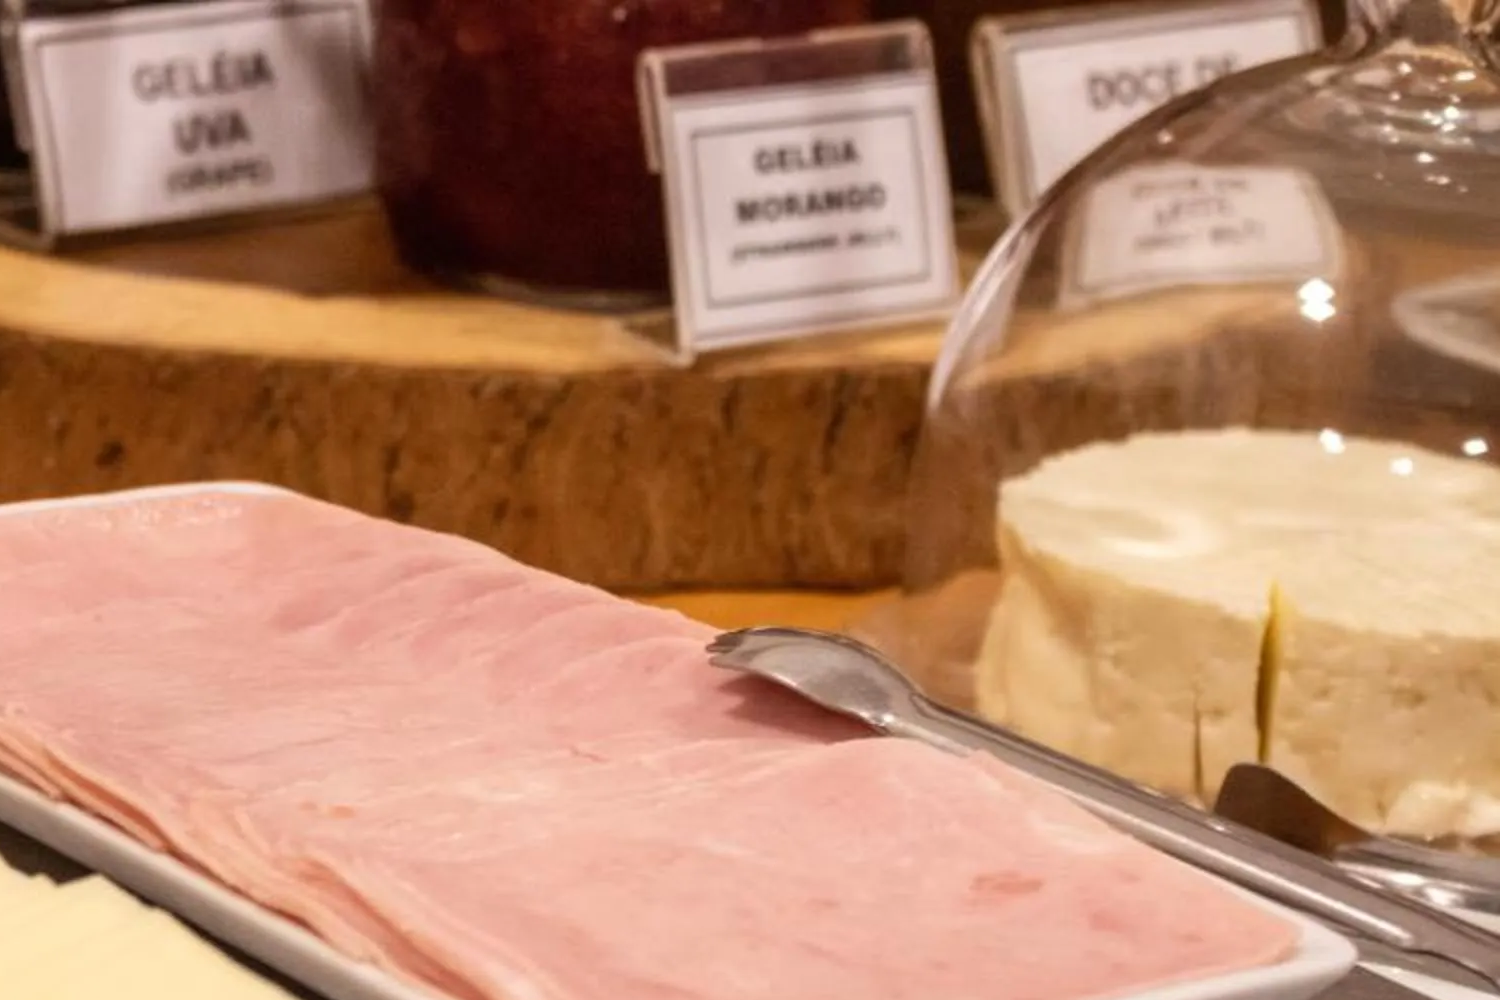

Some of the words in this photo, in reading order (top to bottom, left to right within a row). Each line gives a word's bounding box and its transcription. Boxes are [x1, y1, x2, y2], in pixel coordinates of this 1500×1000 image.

[1087, 62, 1180, 109] DOCE
[173, 109, 251, 156] UVA
[736, 184, 886, 222] MORANGO
